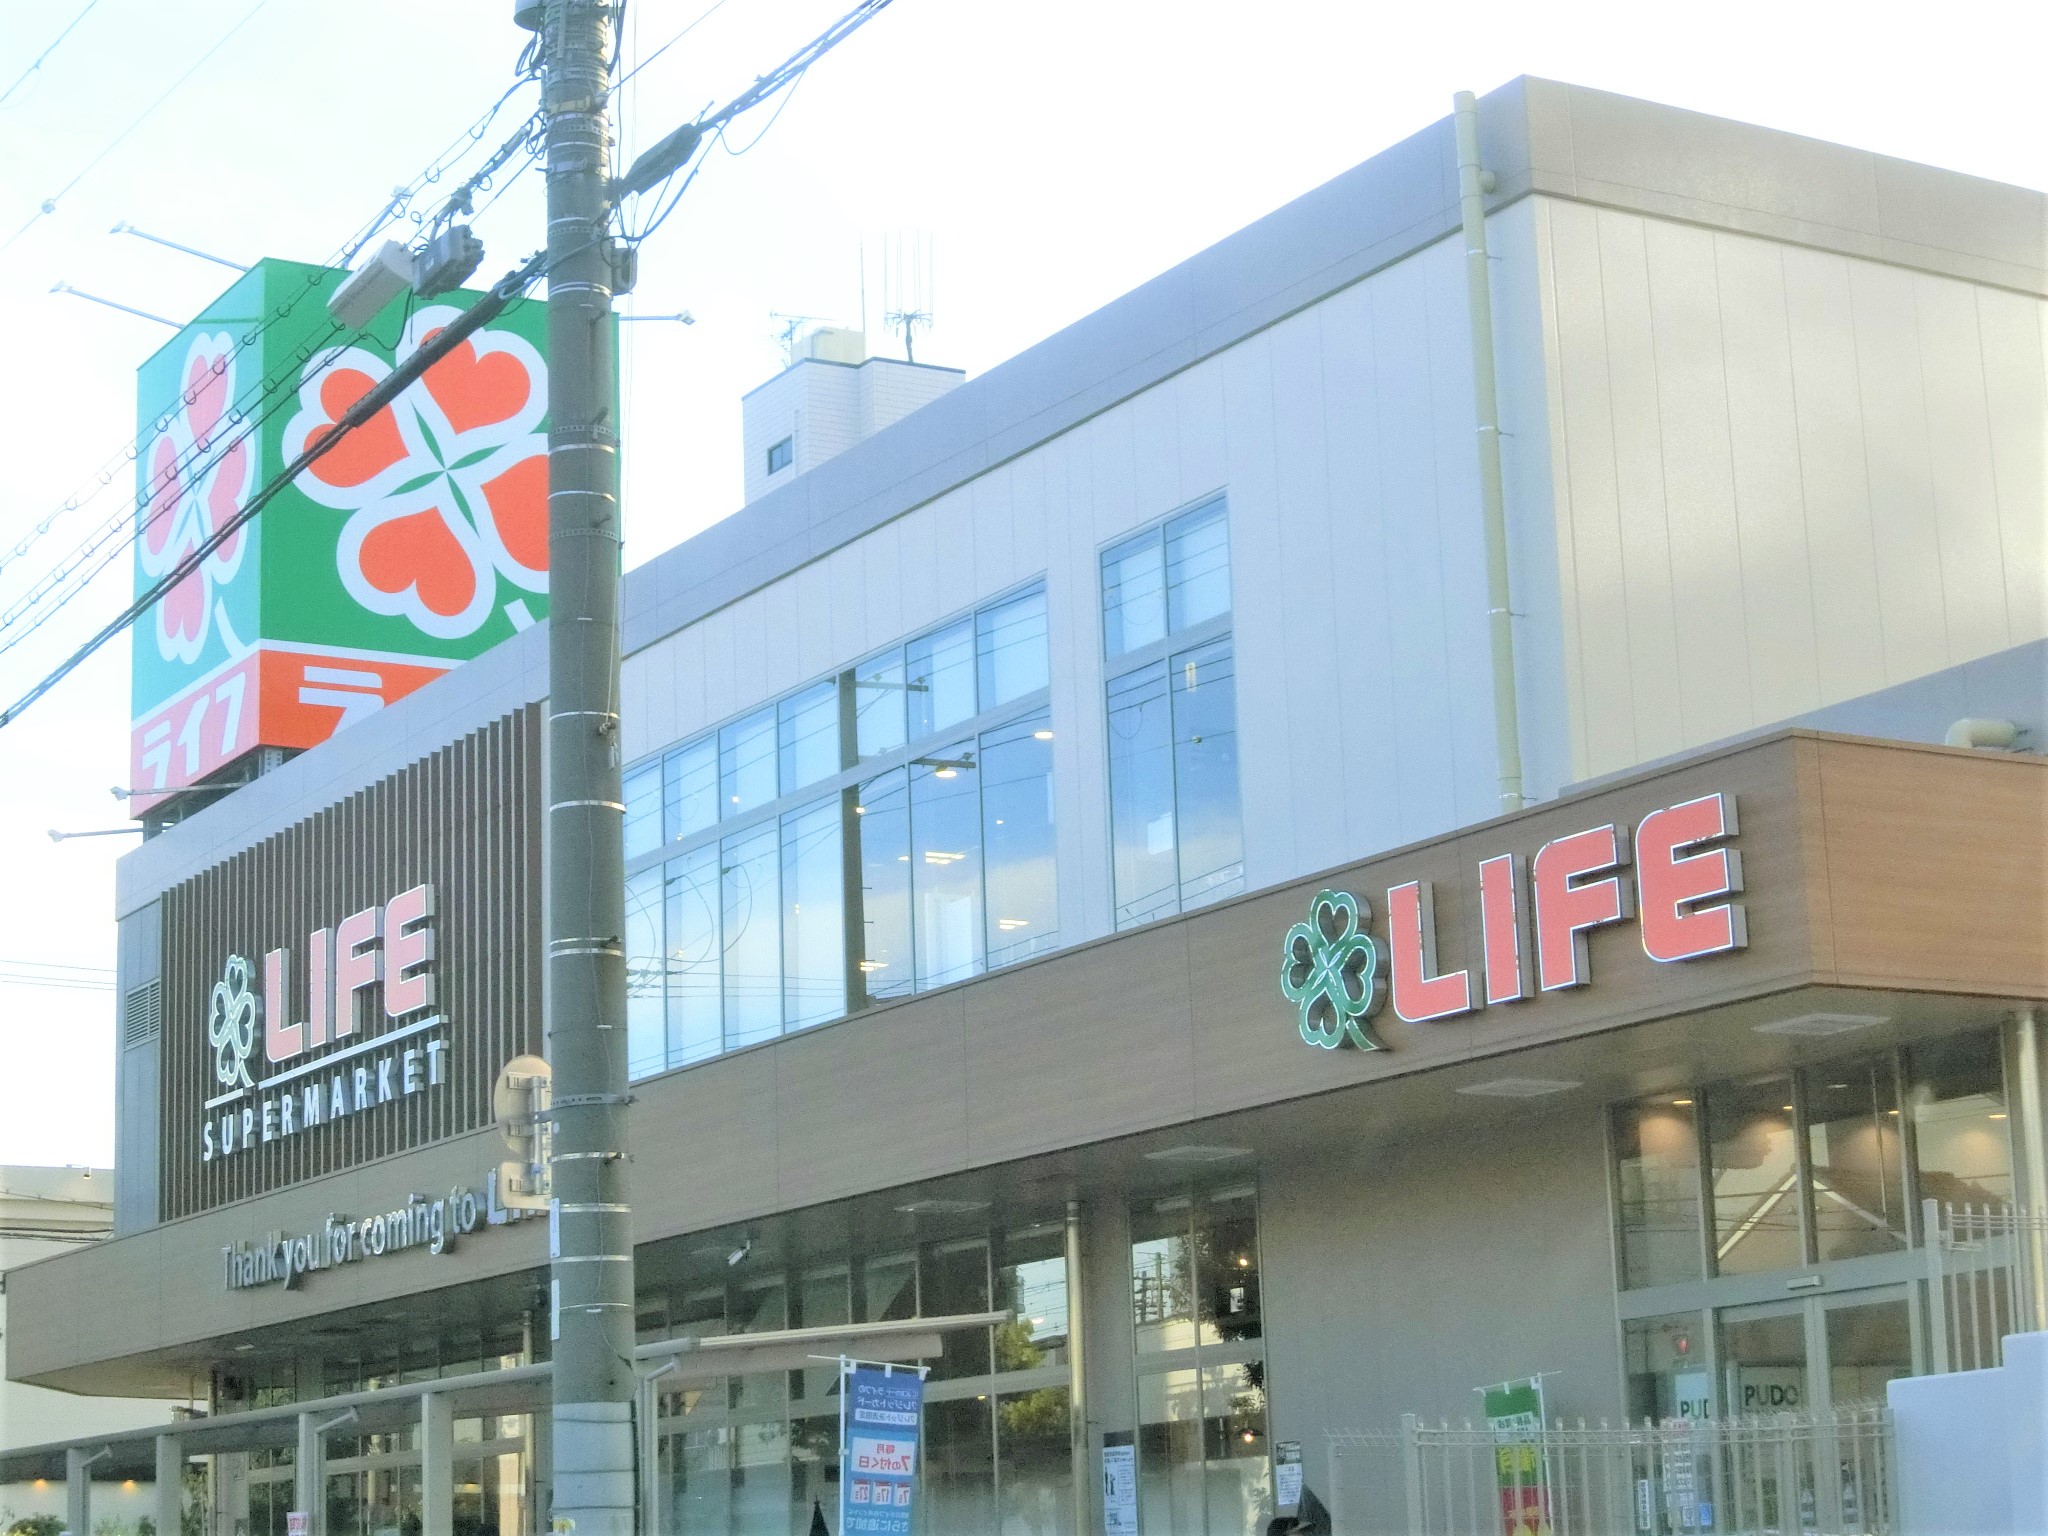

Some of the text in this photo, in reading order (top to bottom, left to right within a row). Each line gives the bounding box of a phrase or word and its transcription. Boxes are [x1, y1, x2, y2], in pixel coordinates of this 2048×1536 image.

[142, 670, 247, 799] ライフ
[1387, 792, 1748, 1024] LIFE
[264, 883, 435, 1064] LIFE
[203, 1039, 449, 1162] SUPERMARKET
[222, 1232, 283, 1290] Thank
[282, 1234, 329, 1290] you
[323, 1211, 363, 1267] for
[360, 1192, 455, 1256] coming
[450, 1185, 488, 1235] to
[1744, 1384, 1799, 1407] PUDO
